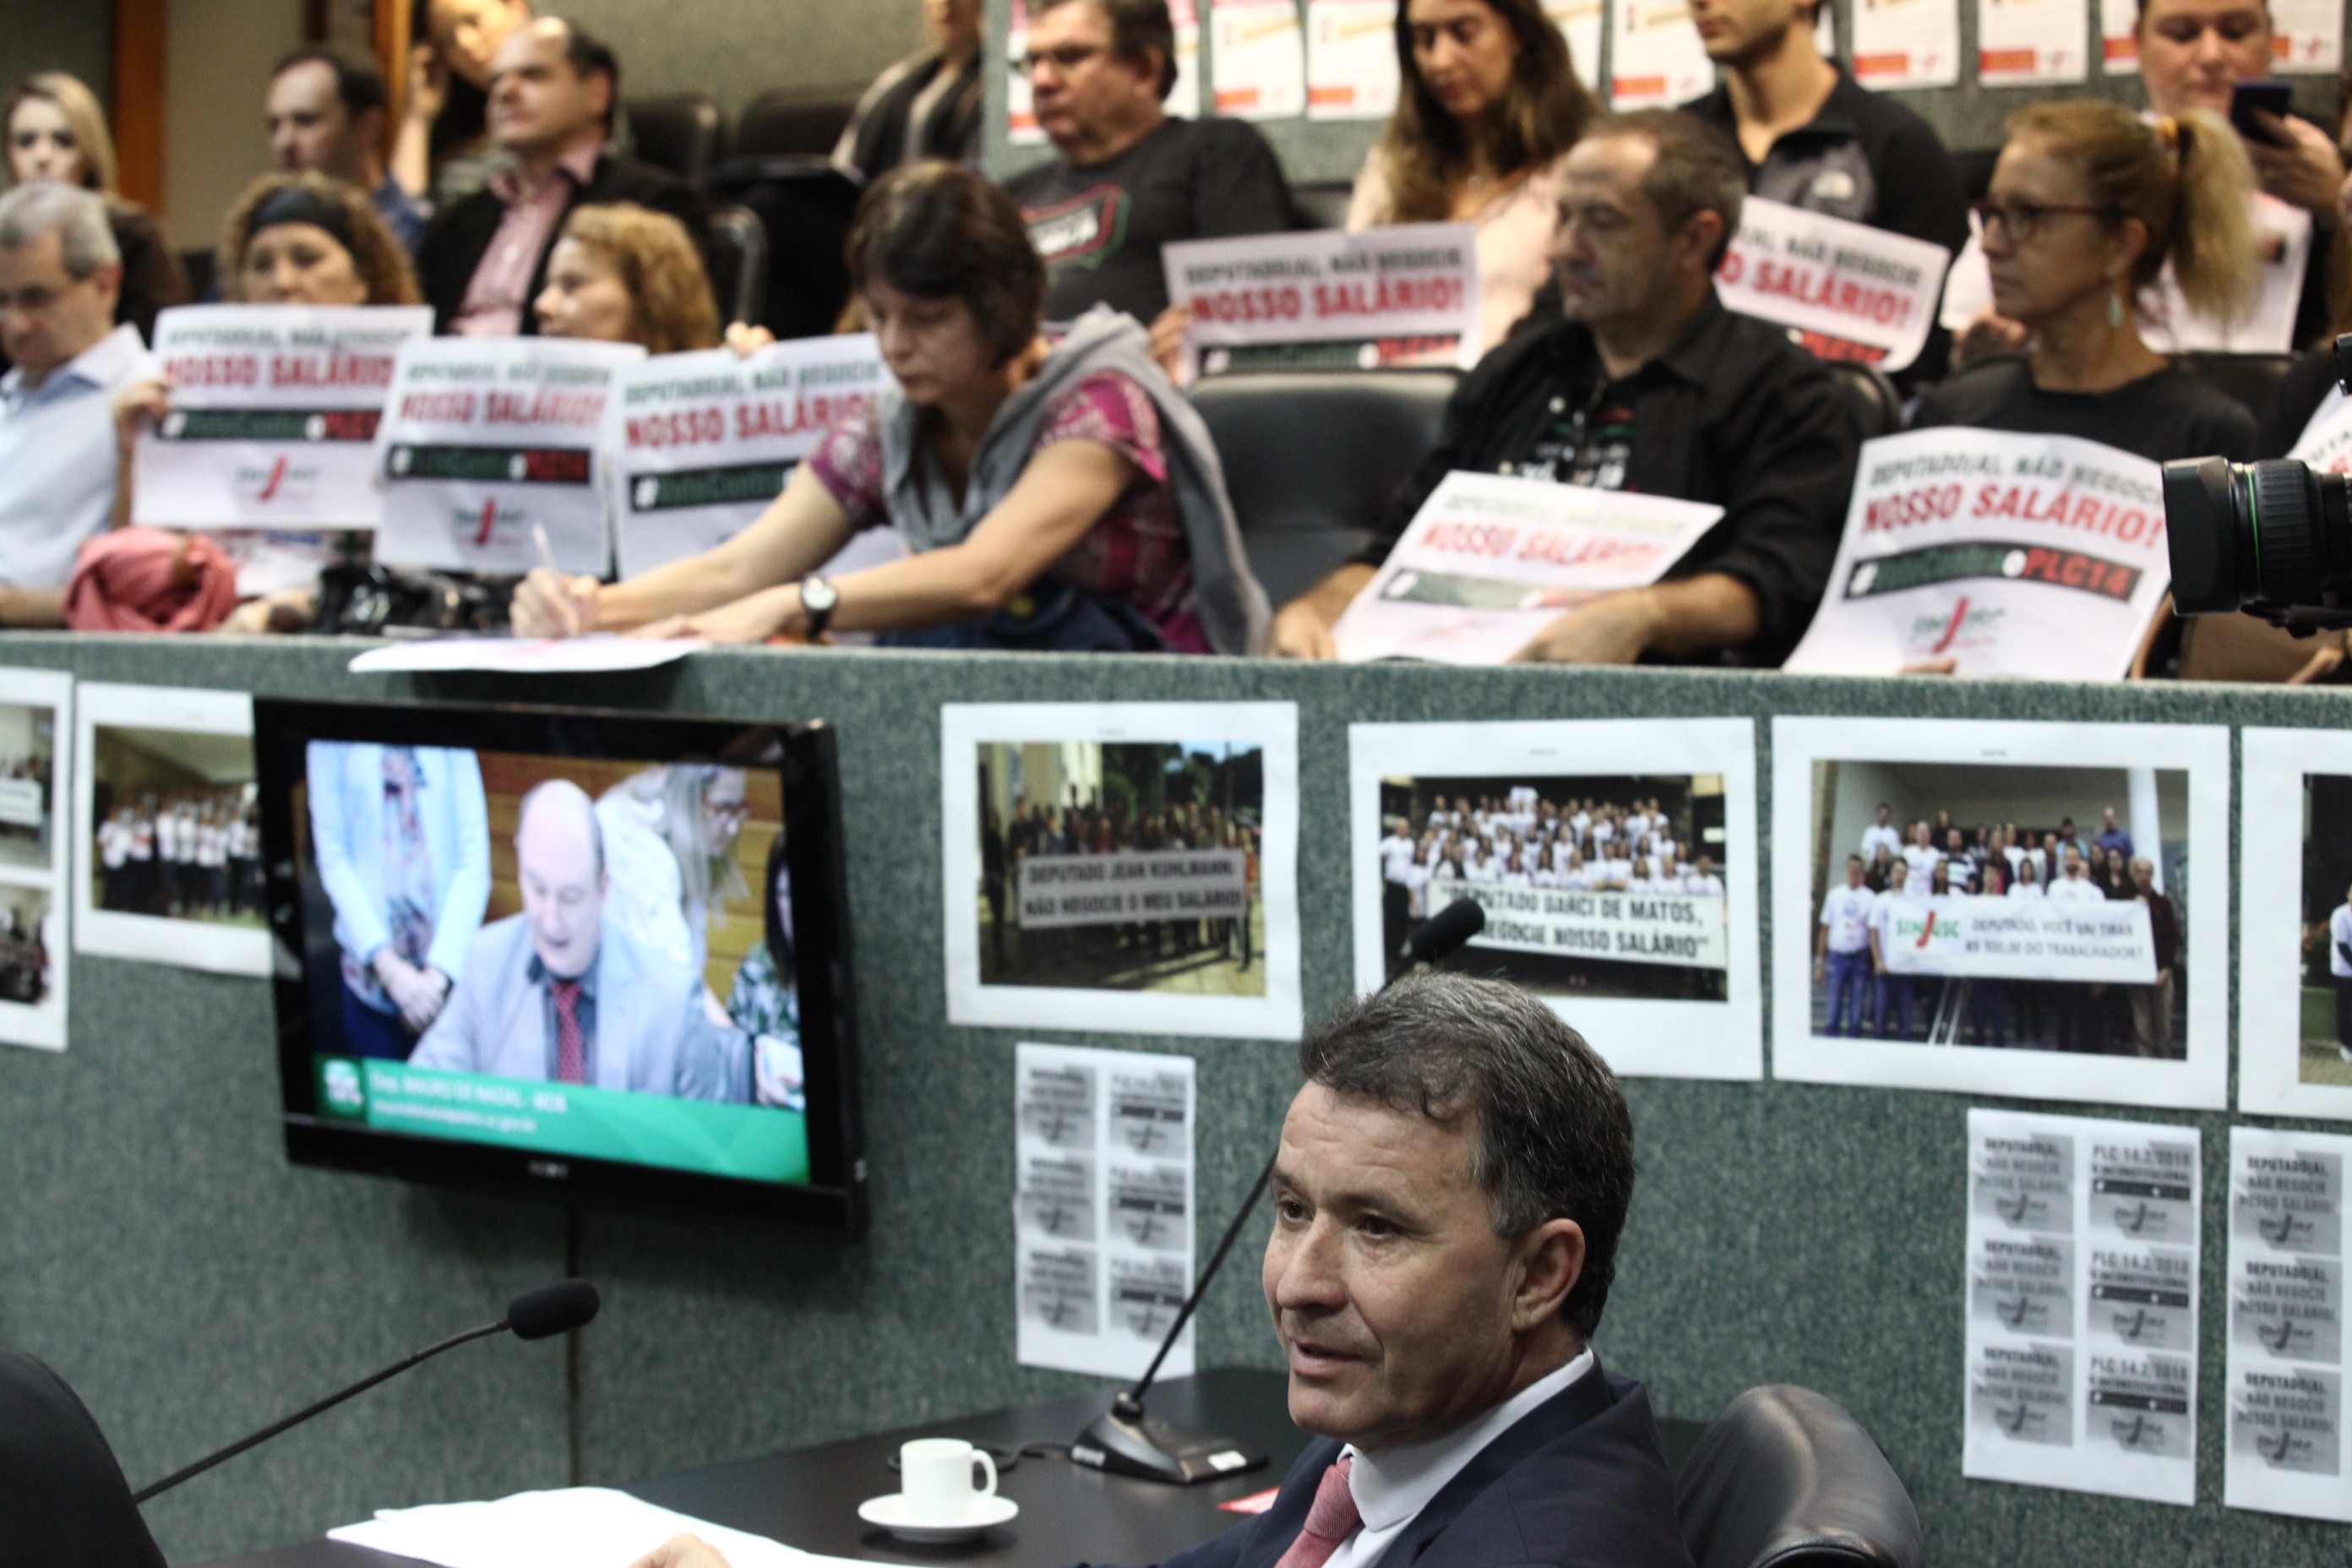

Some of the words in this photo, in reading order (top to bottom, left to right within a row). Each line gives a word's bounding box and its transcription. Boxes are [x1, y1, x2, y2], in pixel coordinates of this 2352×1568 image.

[1191, 285, 1304, 324] NOSSO
[1753, 259, 1912, 331] SALÁRIO!
[626, 406, 723, 449] NOSSO
[1861, 482, 1963, 534] NOSSO
[1970, 482, 2164, 551] SALÁRIO!
[2022, 546, 2132, 598] PLC14
[1601, 898, 1622, 919] DE
[1630, 899, 1703, 927] MATOS,
[1554, 928, 1610, 951] NOSSO
